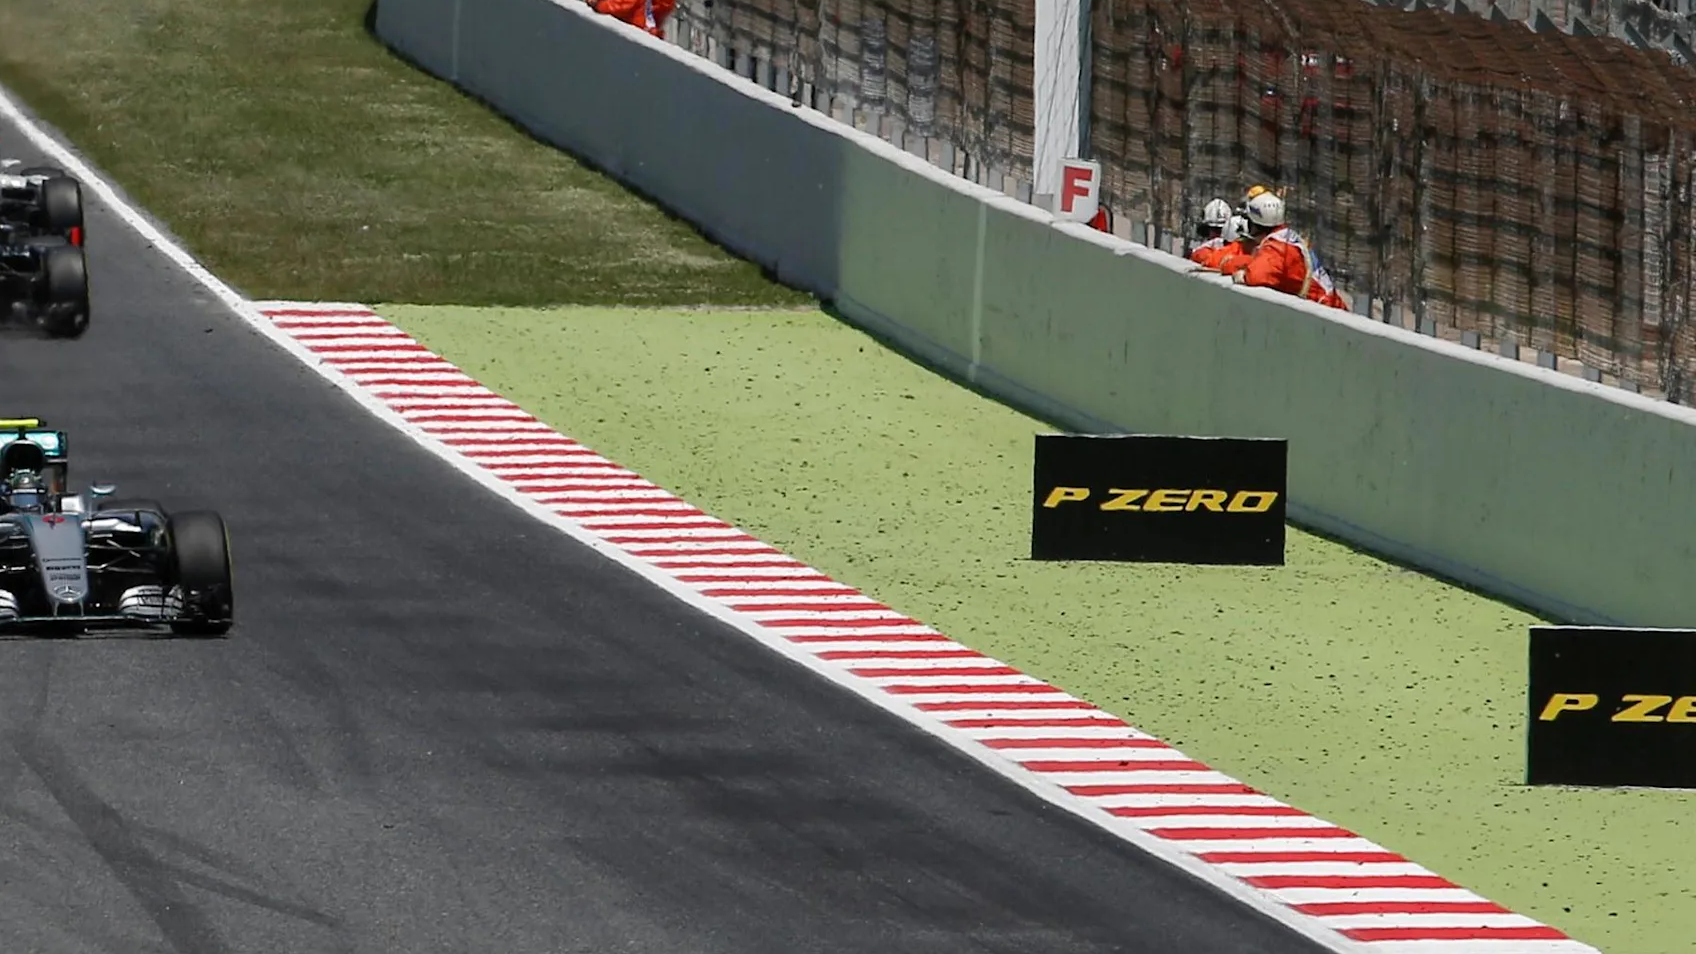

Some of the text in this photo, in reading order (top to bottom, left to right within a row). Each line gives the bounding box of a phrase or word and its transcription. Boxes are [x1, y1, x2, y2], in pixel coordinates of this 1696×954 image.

[1060, 166, 1092, 212] F
[1043, 486, 1278, 513] P ZERO
[1540, 694, 1598, 721] P
